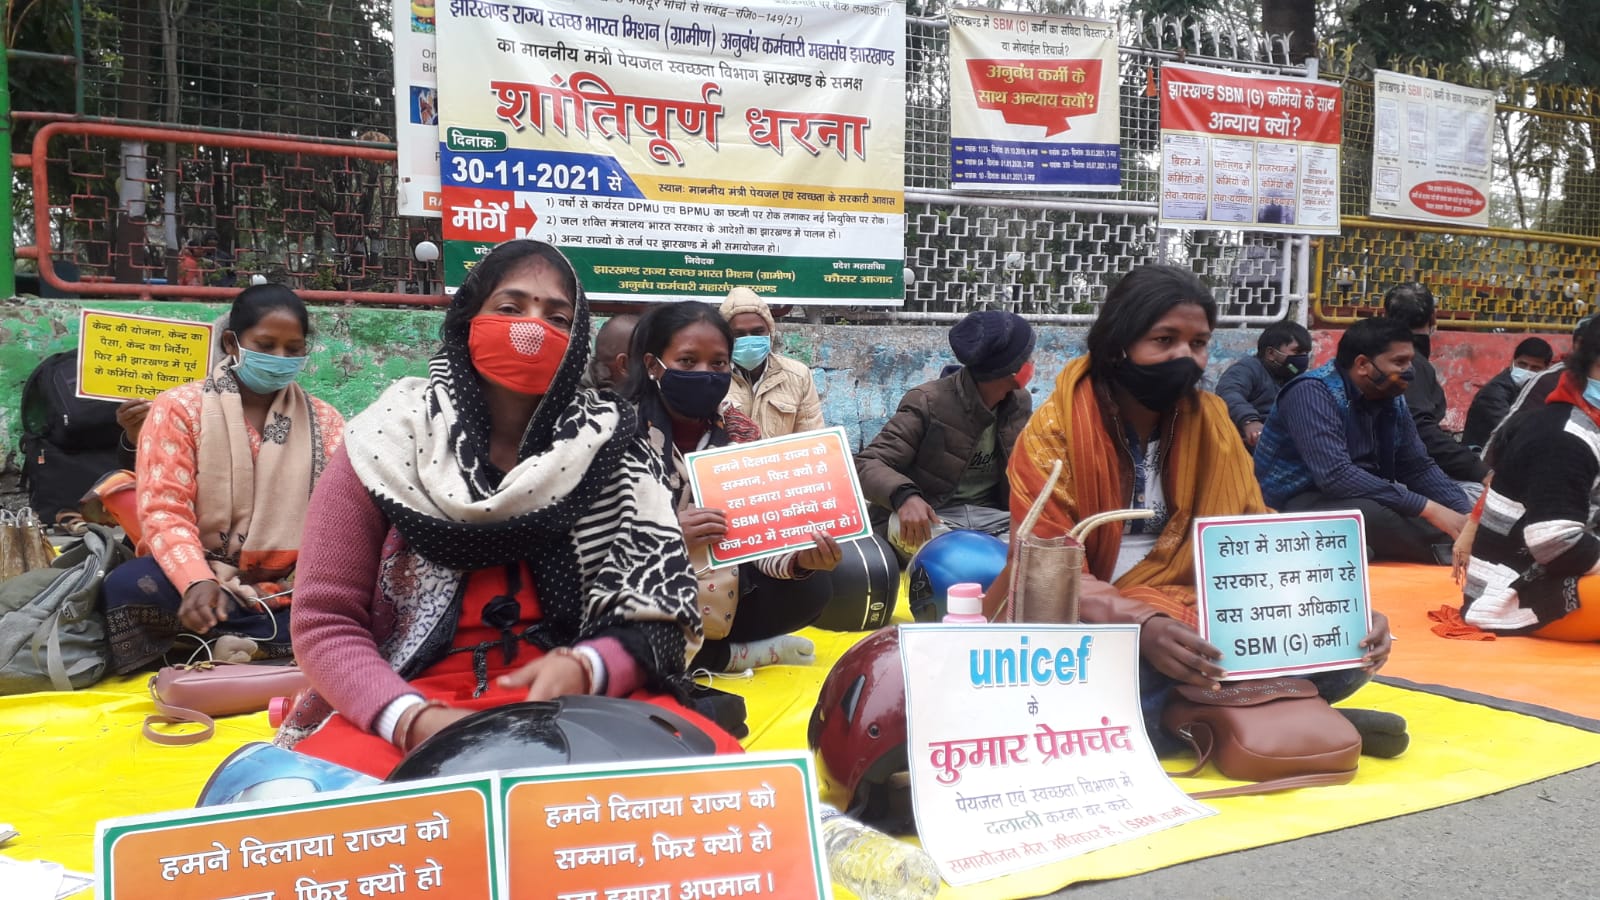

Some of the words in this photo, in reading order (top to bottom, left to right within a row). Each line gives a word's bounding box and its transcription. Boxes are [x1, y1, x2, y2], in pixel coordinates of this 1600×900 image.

[449, 1, 508, 22] झारखण्ड
[513, 6, 544, 26] राज्य
[549, 11, 582, 30] स्वच्छ
[586, 15, 618, 37] भारत
[622, 15, 660, 42] मिशन
[664, 18, 716, 55] (ग्रामीण)
[720, 29, 759, 58] अनुबंध
[762, 33, 805, 59] कर्मचारी
[808, 40, 847, 62] महासंघ
[849, 48, 895, 66] झारखण्ड
[993, 20, 1014, 31] SBM
[1016, 21, 1029, 35] (G)
[1031, 20, 1047, 33] कर्मी
[1049, 24, 1058, 34] का
[497, 38, 515, 54] का
[520, 42, 579, 62] माननीय
[584, 46, 612, 66] मंत्री
[617, 49, 663, 71] पेयजल
[668, 61, 715, 78] स्वच्छता
[719, 61, 758, 82] विभाग
[763, 70, 812, 87] झारखण्ड
[815, 70, 826, 88] के
[831, 77, 864, 91] समक्ष
[986, 63, 1034, 83] अनुबंध
[1038, 66, 1068, 82] कर्मी
[1072, 67, 1086, 83] के
[978, 90, 1008, 103] साथ
[1011, 92, 1058, 106] अन्याय
[1168, 81, 1215, 100] झारखण्ड
[1217, 85, 1244, 103] SBM
[1247, 89, 1264, 108] (G)
[1305, 90, 1315, 110] के
[1317, 97, 1335, 112] साथ
[489, 71, 724, 167] शांतिपूर्ण
[745, 106, 870, 161] धरना
[1208, 111, 1260, 133] अन्याय
[1265, 111, 1301, 136] क्यों?
[451, 156, 600, 191] 30-11-2021
[607, 171, 622, 191] से
[688, 184, 725, 196] माननीय
[750, 186, 779, 200] पेयजल
[828, 191, 836, 202] के
[839, 192, 869, 204] सरकारी
[872, 196, 895, 206] आवास
[451, 199, 510, 232] मांगें
[580, 197, 588, 208] से
[592, 199, 624, 210] कार्यरत
[628, 202, 659, 213] DPMU
[680, 206, 710, 216] BPMU
[753, 210, 763, 219] पर
[766, 208, 780, 220] रोक
[783, 212, 810, 222] लगाकर
[813, 212, 824, 225] नई
[827, 212, 857, 226] नियुक्ति
[560, 216, 578, 226] जल
[582, 215, 607, 227] शक्ति
[611, 217, 644, 229] मंत्रालय
[648, 221, 670, 231] भारत
[674, 223, 703, 233] सरकार
[707, 222, 715, 233] के
[760, 228, 792, 238] झारखण्ड
[803, 230, 825, 238] पालन
[561, 235, 582, 243] अन्य
[615, 235, 624, 245] के
[628, 235, 643, 246] तर्ज
[646, 239, 658, 247] पर
[662, 240, 697, 249] झारखण्ड
[711, 241, 721, 250] भी
[725, 241, 765, 252] समायोजन
[593, 265, 640, 276] झारखण्ड
[656, 281, 696, 291] कर्मचारी
[92, 320, 112, 331] केन्द्र
[115, 323, 128, 332] की
[168, 329, 188, 340] केन्द्र
[126, 339, 145, 350] केन्द्र
[149, 344, 160, 352] का
[95, 351, 112, 361] फिर
[116, 354, 127, 363] भी
[131, 356, 168, 367] झारखण्ड
[141, 372, 153, 381] को
[157, 373, 179, 383] किया
[712, 459, 740, 474] हमने
[743, 454, 780, 468] दिलाया
[784, 449, 809, 460] राज्य
[813, 444, 827, 455] को
[768, 469, 789, 481] फिर
[816, 462, 828, 473] हो
[727, 497, 745, 509] रहा
[748, 491, 780, 505] हमारा
[731, 515, 759, 528] SBM
[762, 511, 780, 524] (G)
[766, 529, 776, 541] में
[780, 519, 835, 538] समायोजन
[1218, 536, 1249, 557] होश
[1255, 534, 1268, 554] में
[1275, 531, 1310, 552] आओ
[1315, 530, 1347, 551] हेमंत
[1213, 572, 1274, 590] सरकार,
[1279, 570, 1301, 587] हम
[1305, 564, 1333, 582] मांग
[1338, 561, 1356, 582] रहे
[1216, 608, 1243, 623] बस
[1250, 604, 1292, 621] अपना
[1234, 636, 1277, 657] SBM
[1283, 633, 1308, 656] (G)
[969, 635, 1093, 688] unicef
[1027, 695, 1040, 716] के
[928, 733, 1029, 785] कुमार
[1033, 715, 1135, 764] प्रेमचंद
[544, 796, 602, 828] हमने
[608, 793, 683, 822] दिलाया
[689, 790, 743, 814] राज्य
[747, 783, 776, 809] को
[955, 791, 1003, 813] पेयजल
[1031, 783, 1079, 803] स्वच्छता
[1078, 776, 1117, 796] विभाग
[984, 810, 1044, 835] दलाली
[1046, 807, 1079, 825] करना
[1107, 794, 1133, 812] करो
[159, 841, 230, 882] हमने
[239, 834, 335, 868] दिलाया
[343, 823, 407, 852] राज्य
[415, 811, 450, 843] को
[554, 842, 645, 870] सम्मान,
[651, 833, 697, 862] फिर
[702, 827, 743, 856] क्यों
[750, 827, 774, 853] हो
[947, 847, 1022, 874] समायोजन
[294, 877, 351, 900] फिर
[356, 864, 406, 896] क्यों
[413, 858, 443, 892] हो
